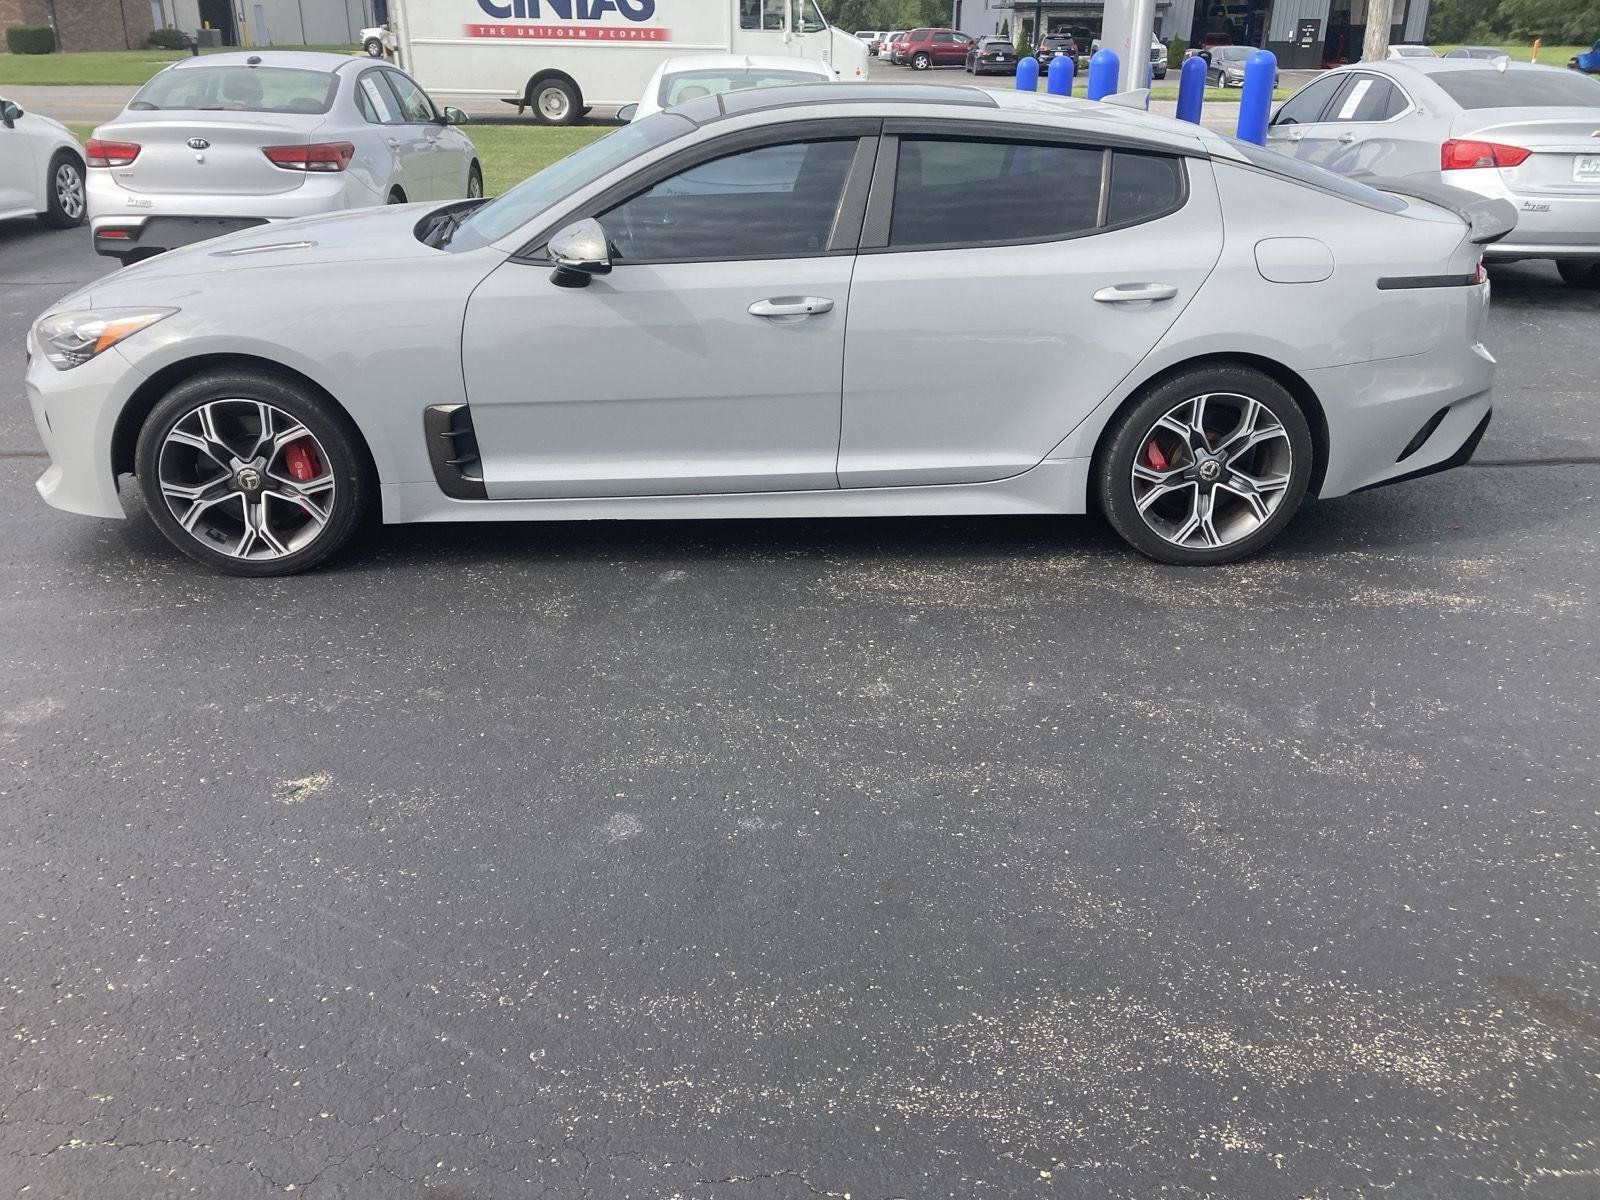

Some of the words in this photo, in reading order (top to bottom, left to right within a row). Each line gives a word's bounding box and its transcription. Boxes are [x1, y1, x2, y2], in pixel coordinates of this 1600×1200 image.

[479, 27, 506, 36] THE
[517, 28, 587, 37] UNIFORM
[598, 30, 656, 39] PEOPLE
